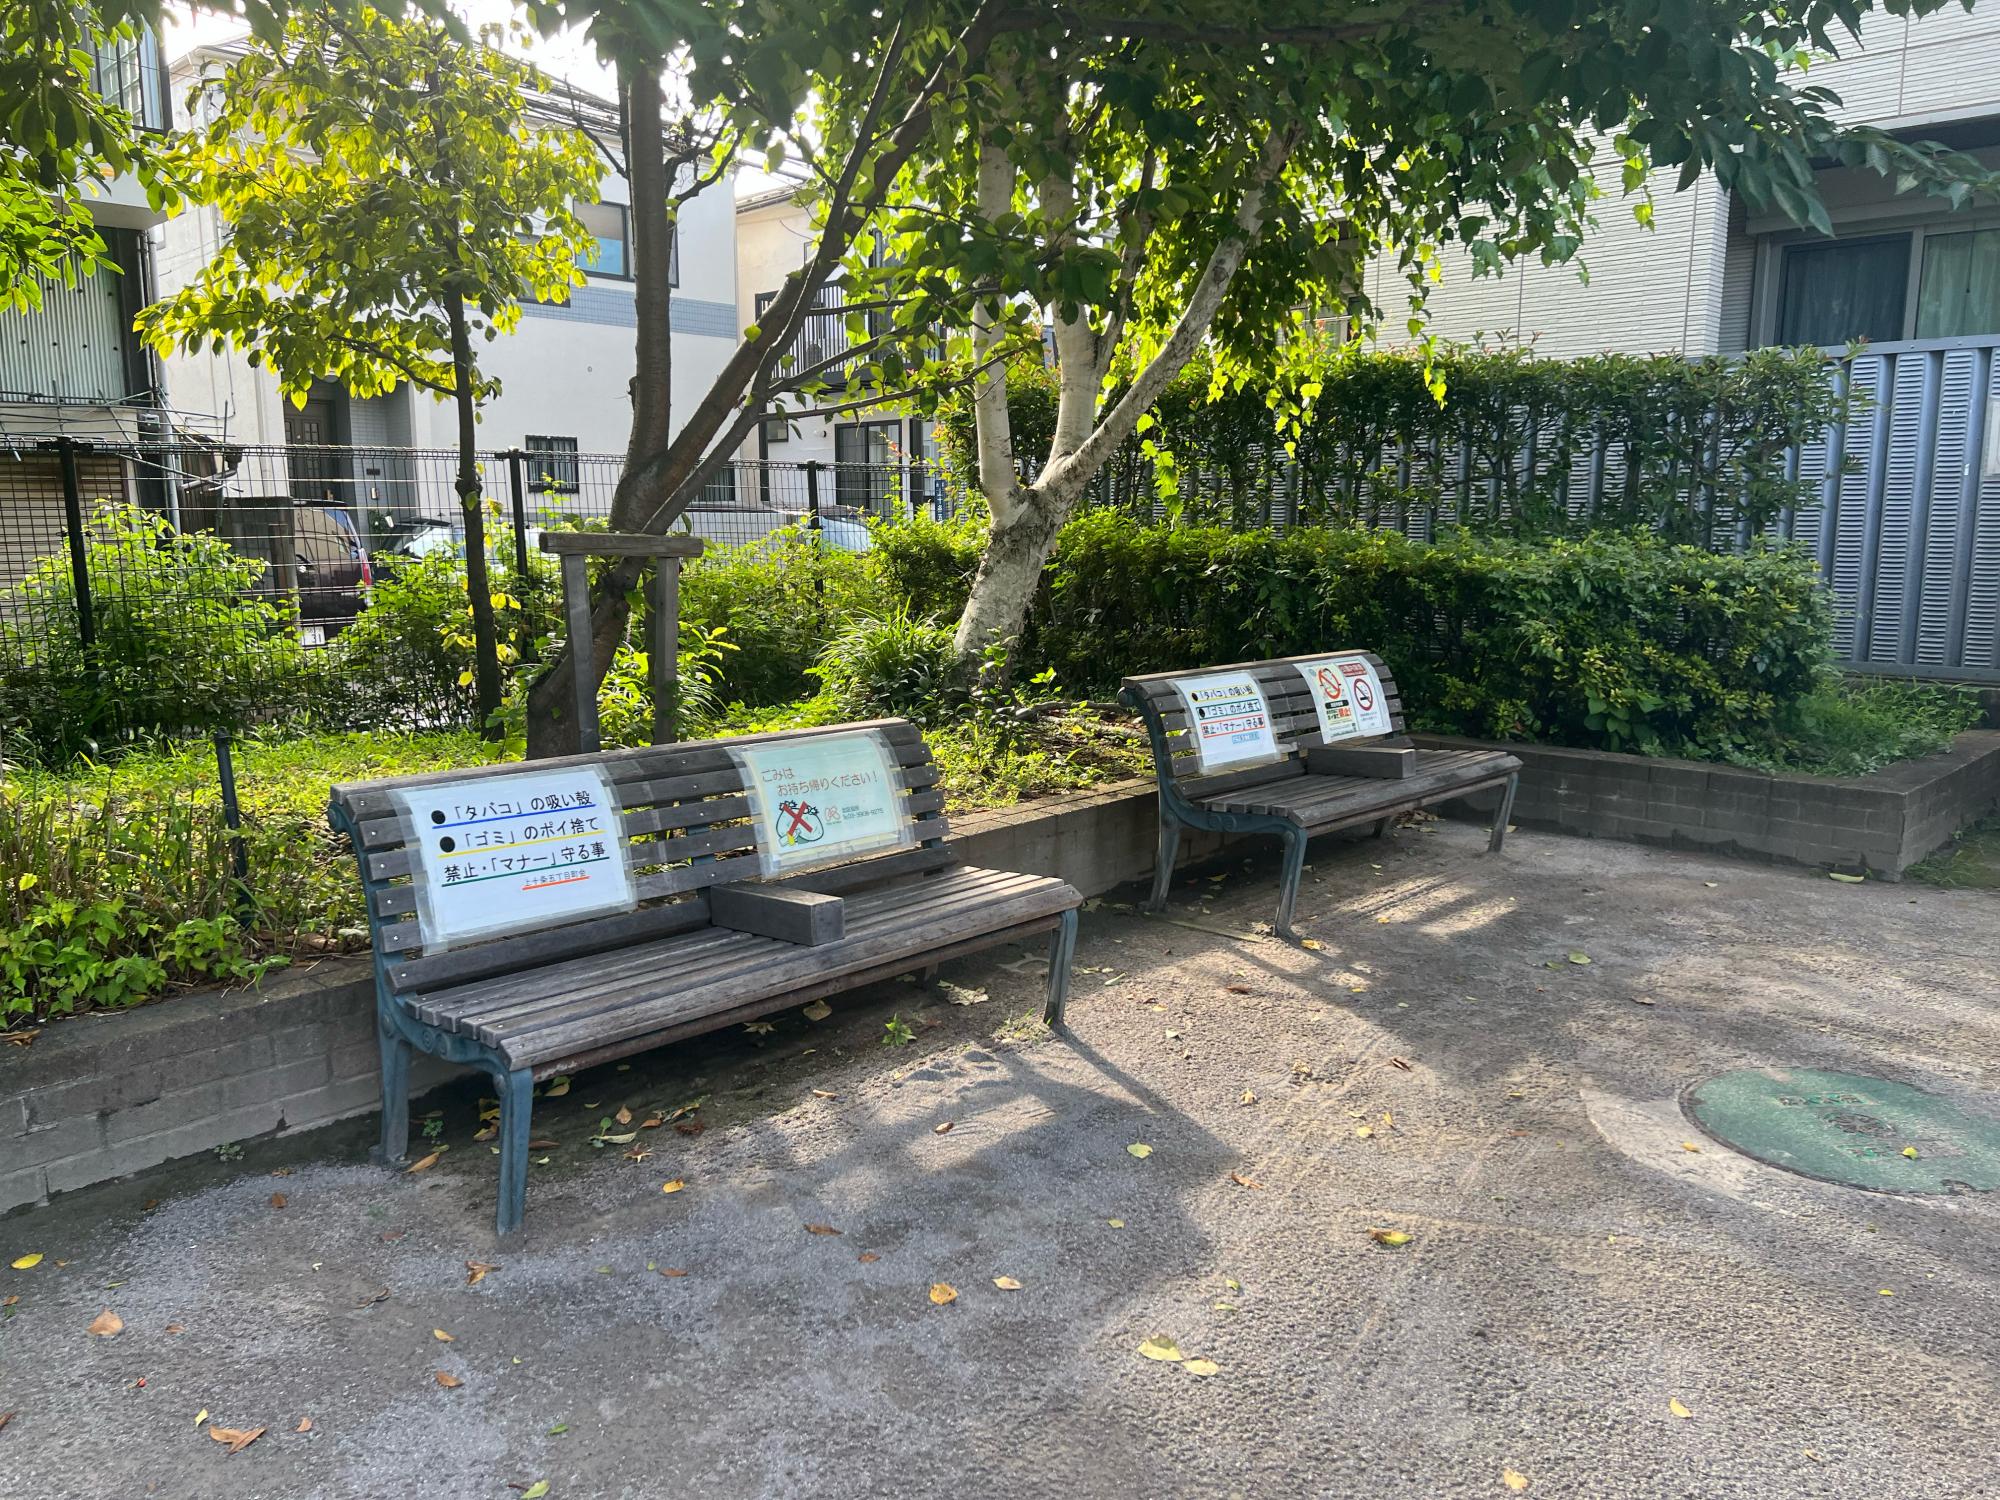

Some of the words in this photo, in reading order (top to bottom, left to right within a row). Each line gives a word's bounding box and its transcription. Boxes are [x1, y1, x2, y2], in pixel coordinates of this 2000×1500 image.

[761, 767, 795, 783] ごみは
[454, 790, 593, 821] 「タバコ」の吸い殻
[465, 816, 600, 847] 「ゴミ」のポイ捨て
[444, 841, 606, 882] 禁止・「マナー」守る事
